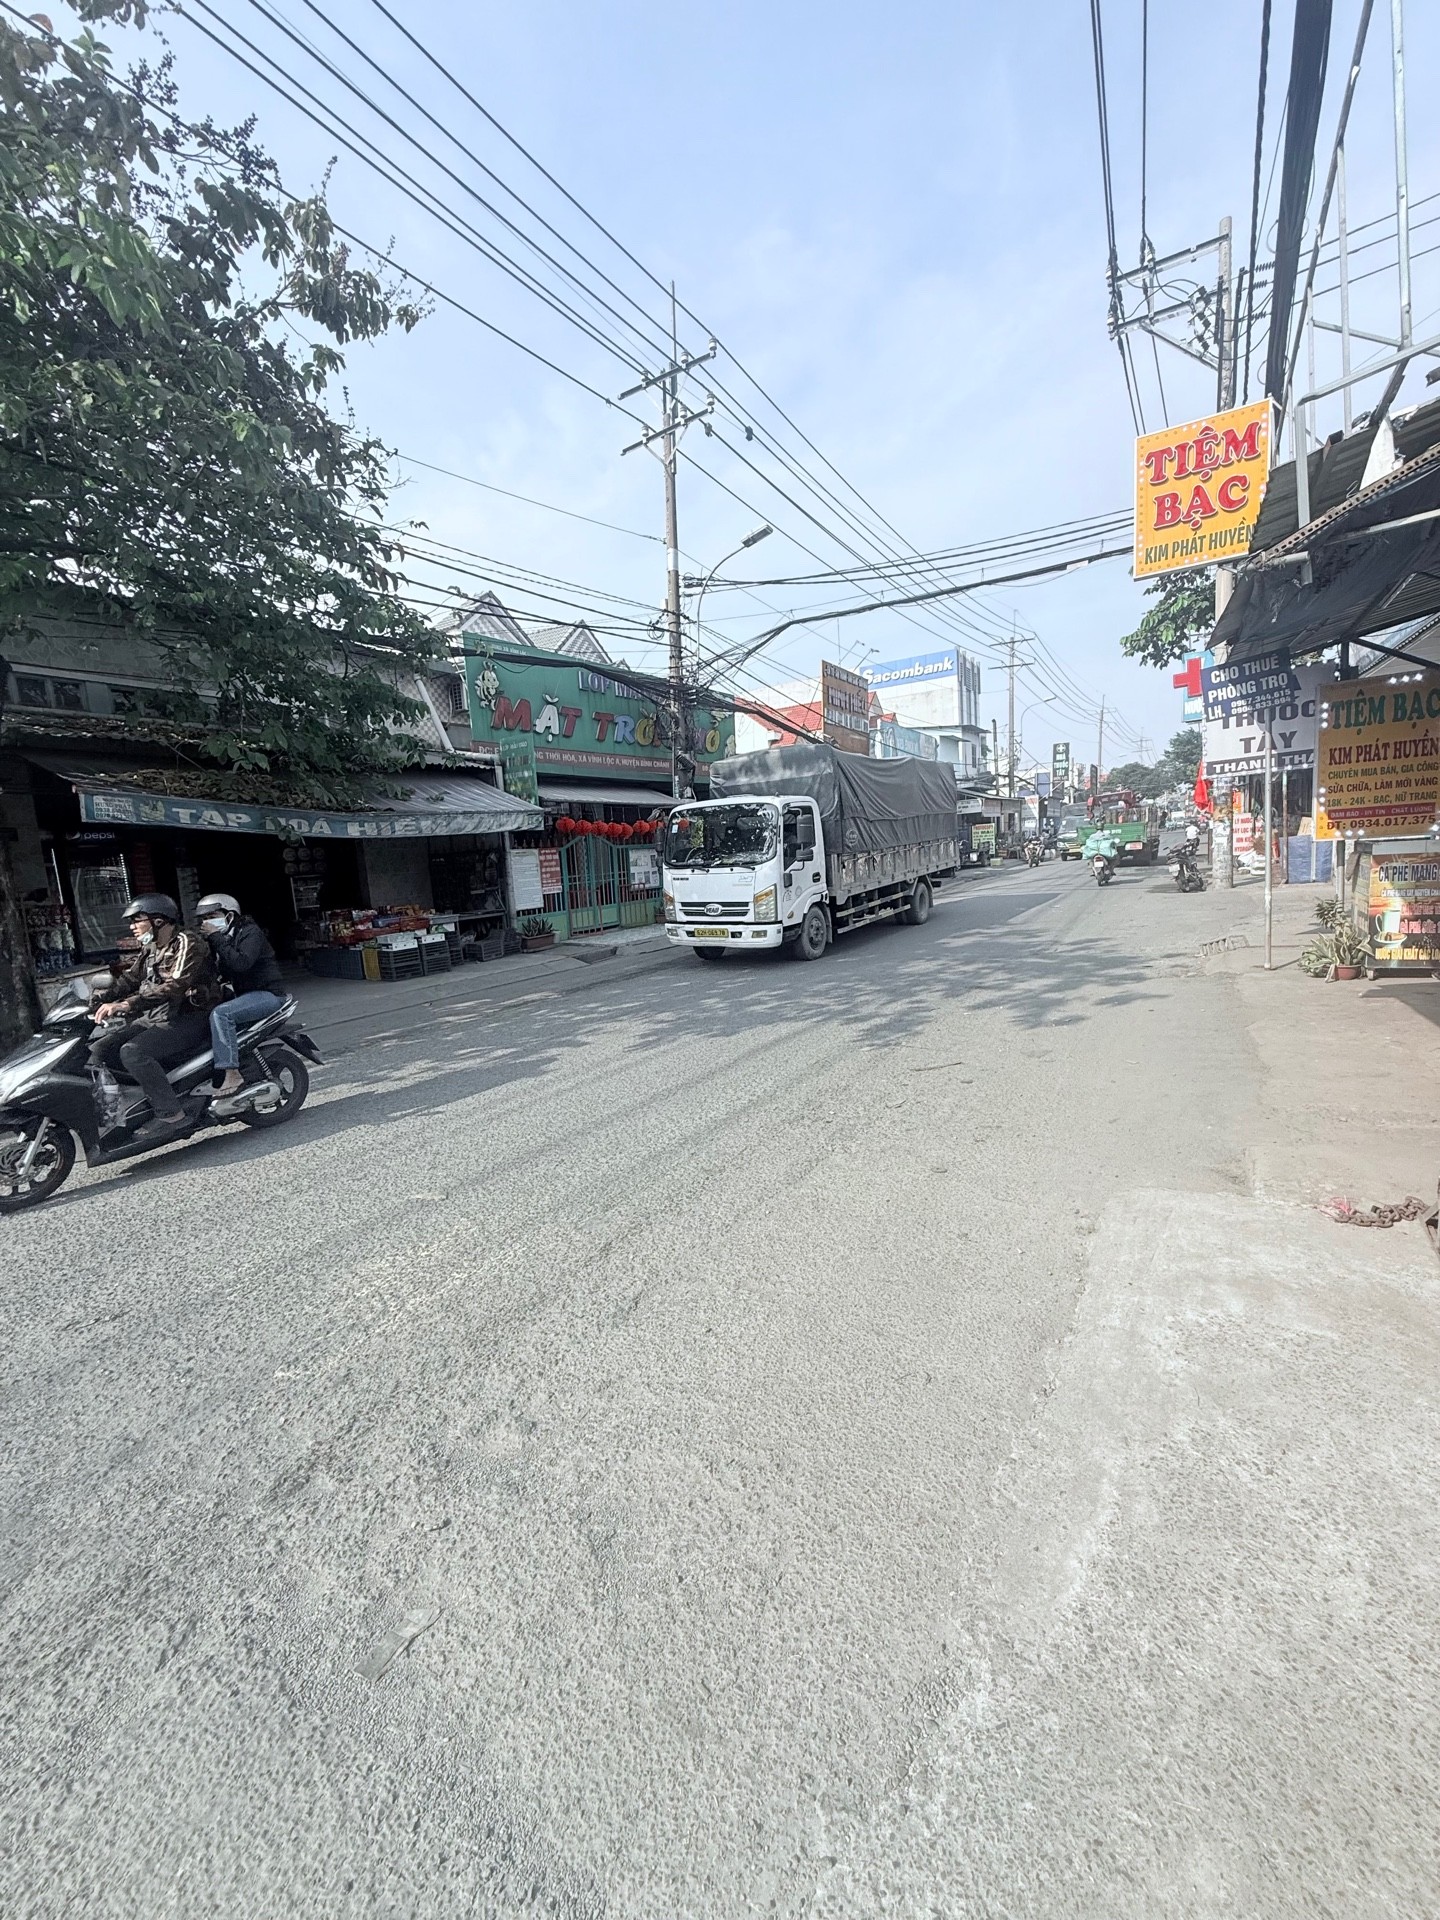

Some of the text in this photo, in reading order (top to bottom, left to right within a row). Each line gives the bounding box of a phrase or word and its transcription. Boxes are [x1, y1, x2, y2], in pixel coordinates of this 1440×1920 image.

[1145, 422, 1261, 484] TIỆM
[1153, 475, 1249, 529] BẠC
[1145, 517, 1255, 565] KIM PHÁT HUYỀN
[862, 657, 954, 685] Sacombank
[1211, 655, 1280, 684] CHO THUÊ
[1208, 672, 1288, 703] PHÒNG TRỌ
[490, 694, 582, 743] MẶT
[1208, 706, 1226, 720] LH.
[1331, 688, 1440, 735] TIỆM BẠC
[1239, 730, 1297, 754] TÂY
[1329, 729, 1439, 766] KIM PHÁT HUYỀN
[1328, 760, 1440, 780] CHUYÊN MUA BÁN, GIA CÔNG
[1328, 783, 1344, 794] SỬA
[1374, 779, 1393, 790] LÀM
[1395, 777, 1412, 788] MỚI
[1414, 775, 1438, 787] VÀNG
[1327, 798, 1342, 807] 18K
[1350, 796, 1365, 806] 24K
[1409, 791, 1438, 801] TRANG
[1350, 815, 1436, 829] 0934.017.375
[1378, 862, 1438, 882] CÀ PHÊ MANG
